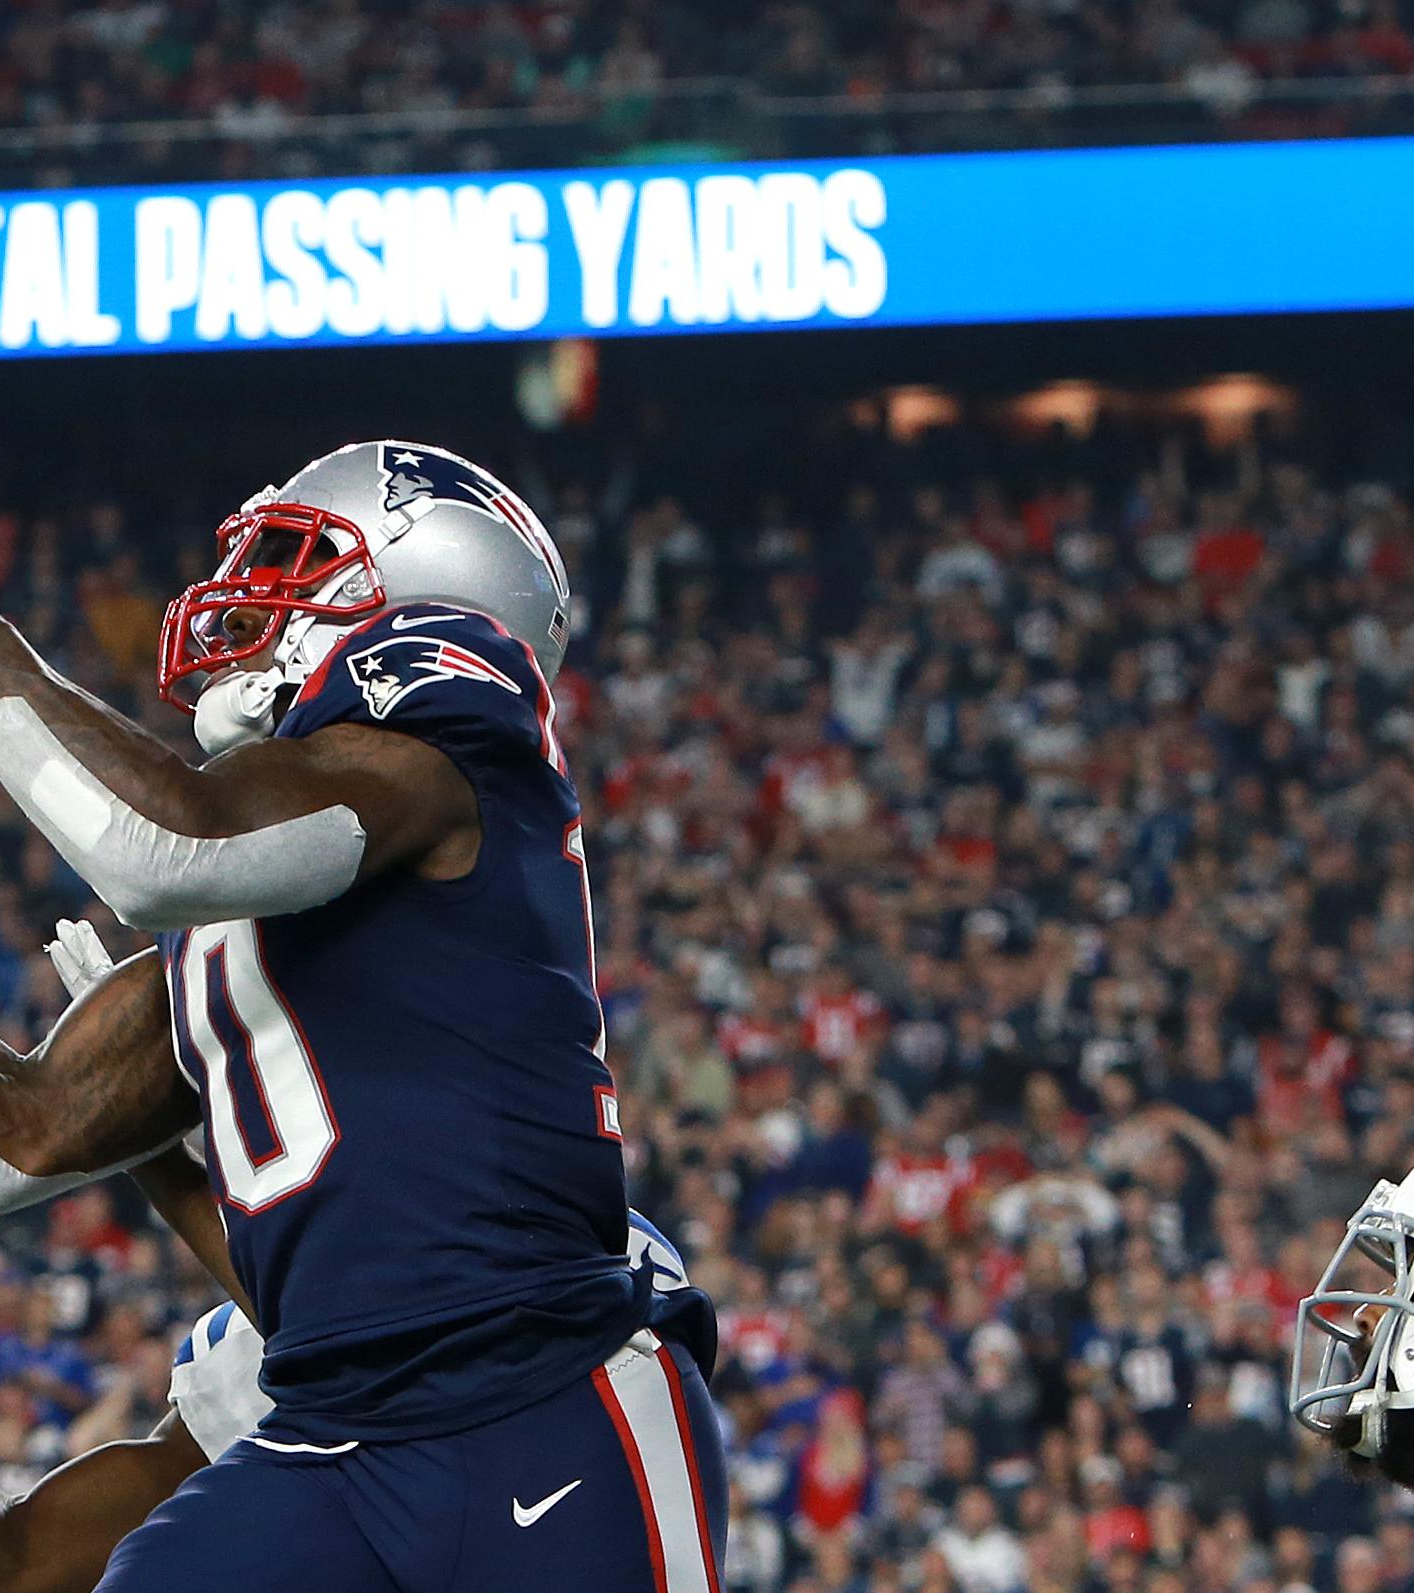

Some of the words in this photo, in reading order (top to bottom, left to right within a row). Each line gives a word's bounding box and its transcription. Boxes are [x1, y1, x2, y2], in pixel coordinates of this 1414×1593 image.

[135, 181, 550, 344] PASSING
[561, 169, 888, 329] YARDS
[164, 917, 342, 1216] 0
